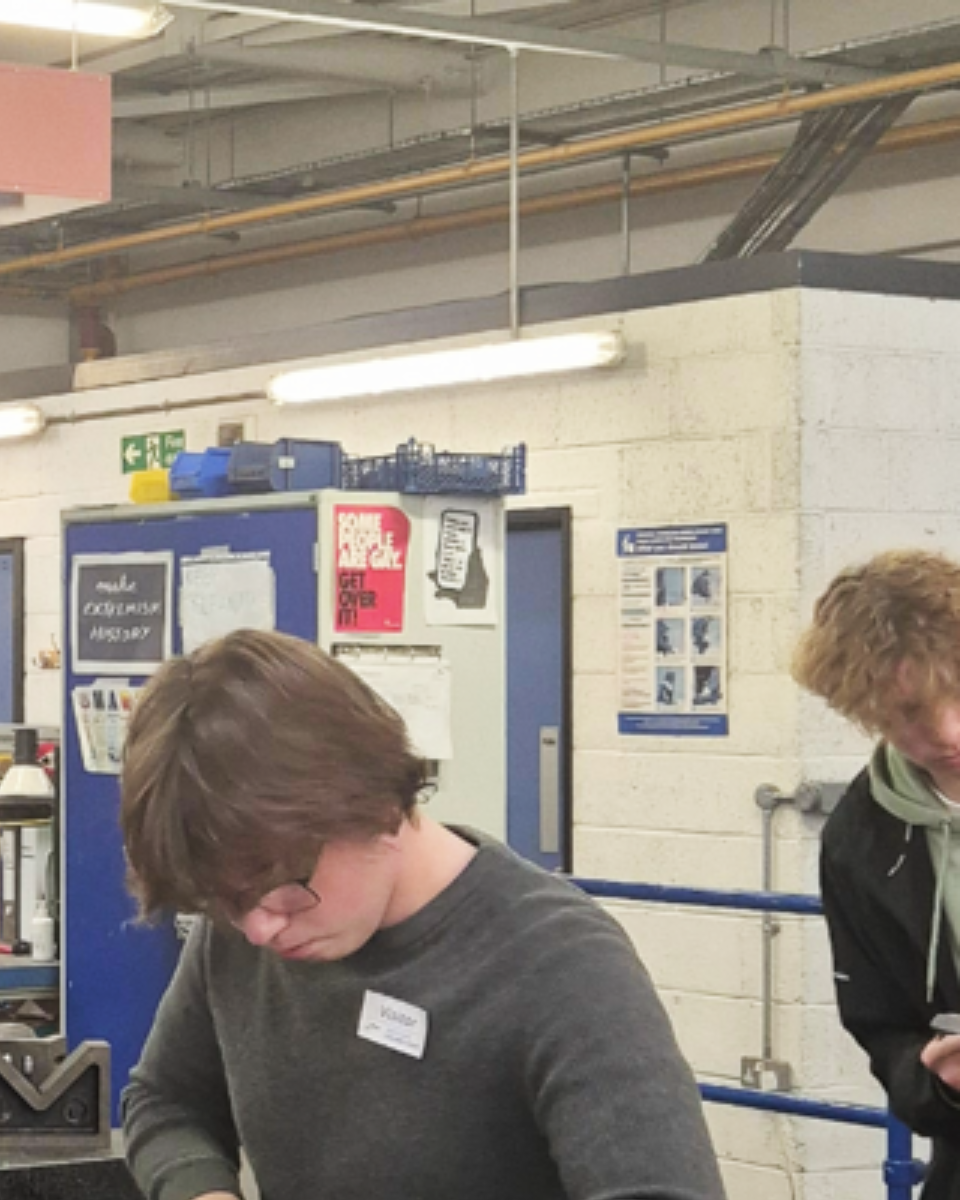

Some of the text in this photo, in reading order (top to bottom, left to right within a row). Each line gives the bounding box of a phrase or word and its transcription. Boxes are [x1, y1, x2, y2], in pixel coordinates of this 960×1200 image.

[339, 512, 381, 531] SOME
[339, 530, 394, 549] PEOPLE
[339, 548, 368, 568] ARE
[339, 573, 365, 590] GET
[339, 590, 376, 609] OVER
[339, 608, 358, 627] IT!
